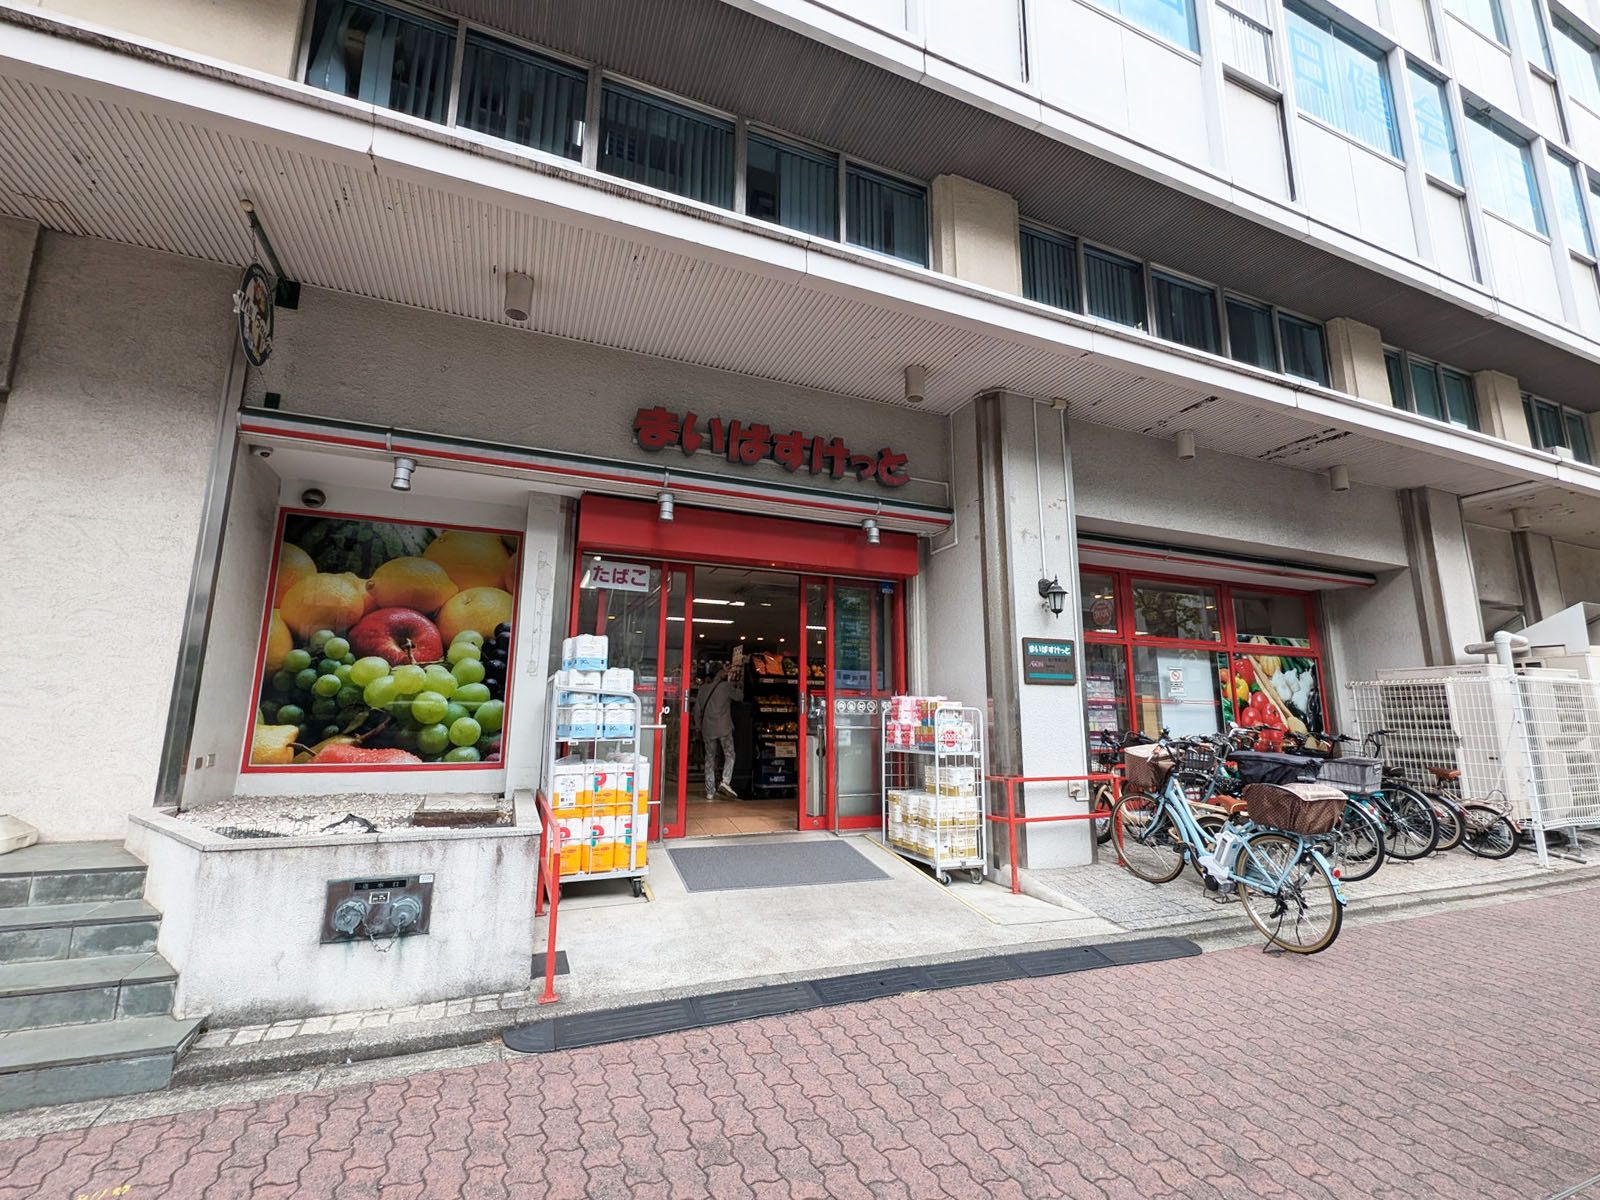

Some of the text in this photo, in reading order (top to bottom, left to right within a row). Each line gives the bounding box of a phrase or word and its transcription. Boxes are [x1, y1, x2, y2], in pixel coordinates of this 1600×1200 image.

[633, 406, 911, 488] まいばすけっと
[592, 565, 647, 587] たばこ
